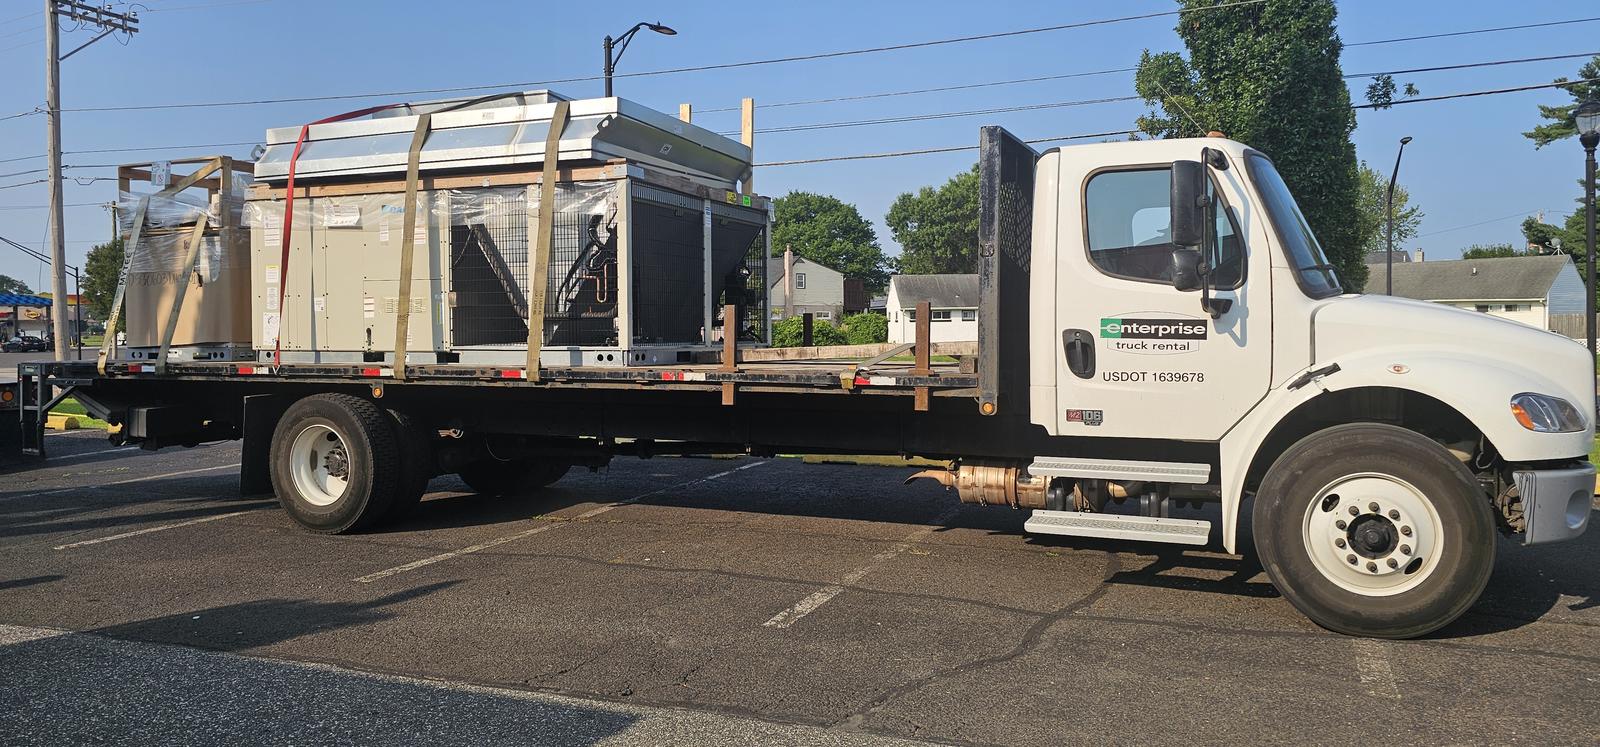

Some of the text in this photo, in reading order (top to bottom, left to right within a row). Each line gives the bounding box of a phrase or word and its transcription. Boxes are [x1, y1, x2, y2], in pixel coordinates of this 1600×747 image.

[1102, 323, 1206, 337] enterprise
[1116, 341, 1190, 351] truck rental
[1102, 371, 1204, 383] USDOT 1639678
[1082, 410, 1101, 420] 106
